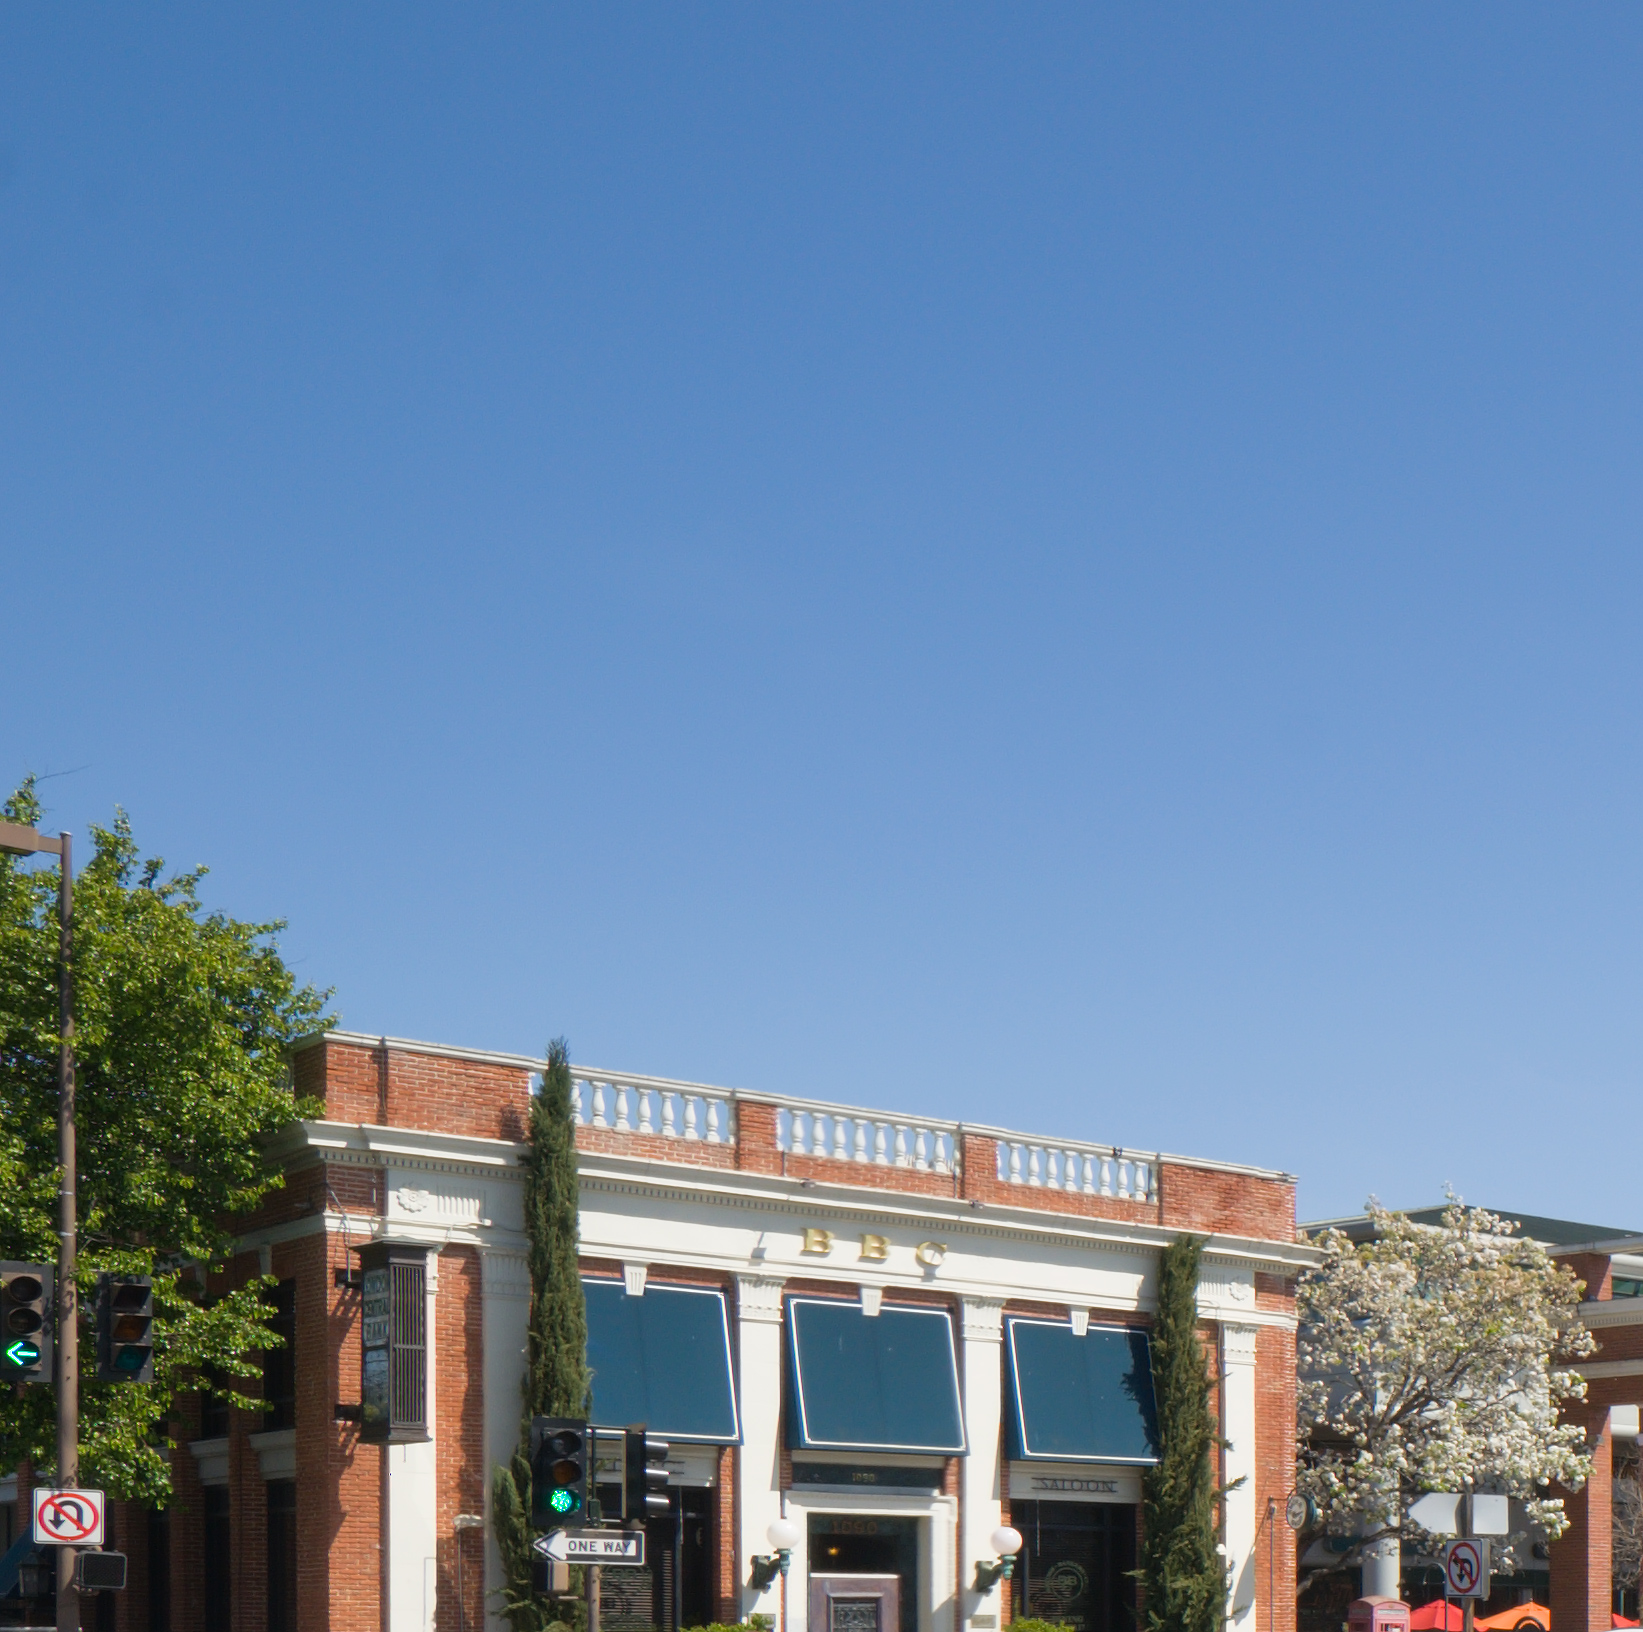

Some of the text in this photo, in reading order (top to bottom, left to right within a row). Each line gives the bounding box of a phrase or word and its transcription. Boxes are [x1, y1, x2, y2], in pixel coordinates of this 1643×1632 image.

[1040, 1479, 1114, 1492] SALOON
[568, 1541, 631, 1553] ONE WAY
